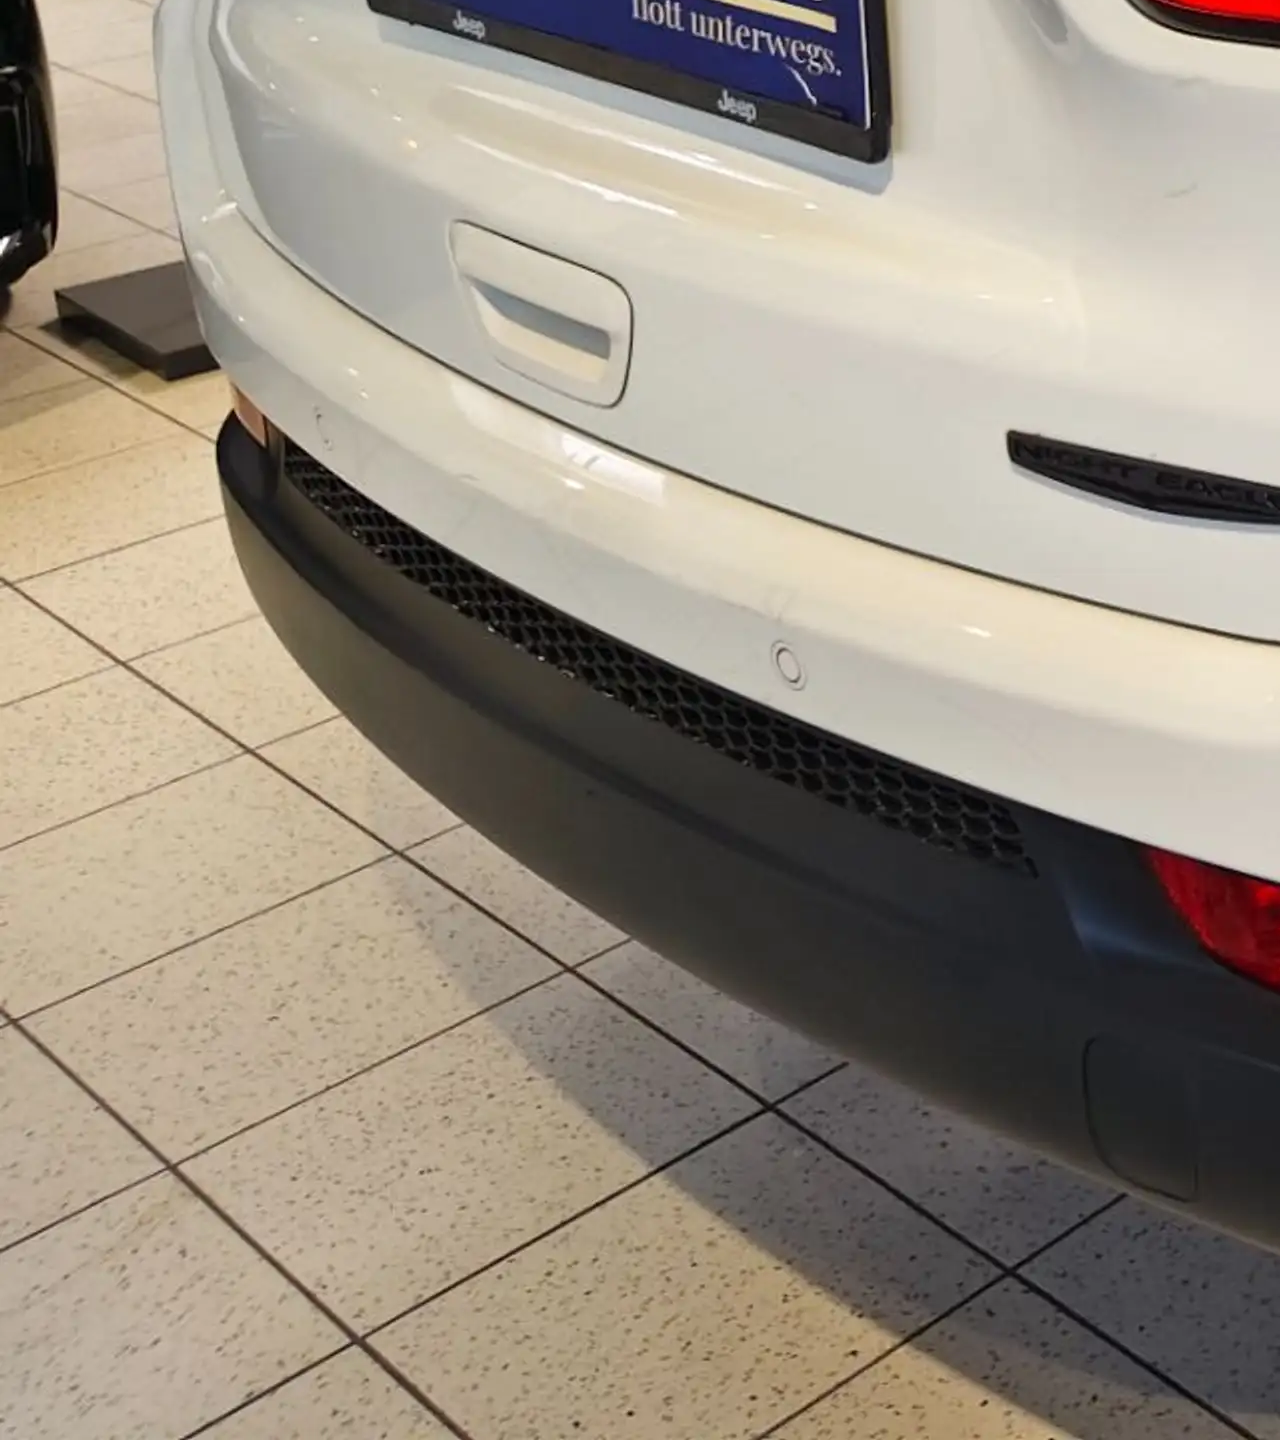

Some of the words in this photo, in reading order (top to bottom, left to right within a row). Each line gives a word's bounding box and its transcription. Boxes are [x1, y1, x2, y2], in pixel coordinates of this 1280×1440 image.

[452, 10, 487, 40] Jeep
[690, 10, 842, 77] unterwegs.
[717, 89, 758, 122] Jeep
